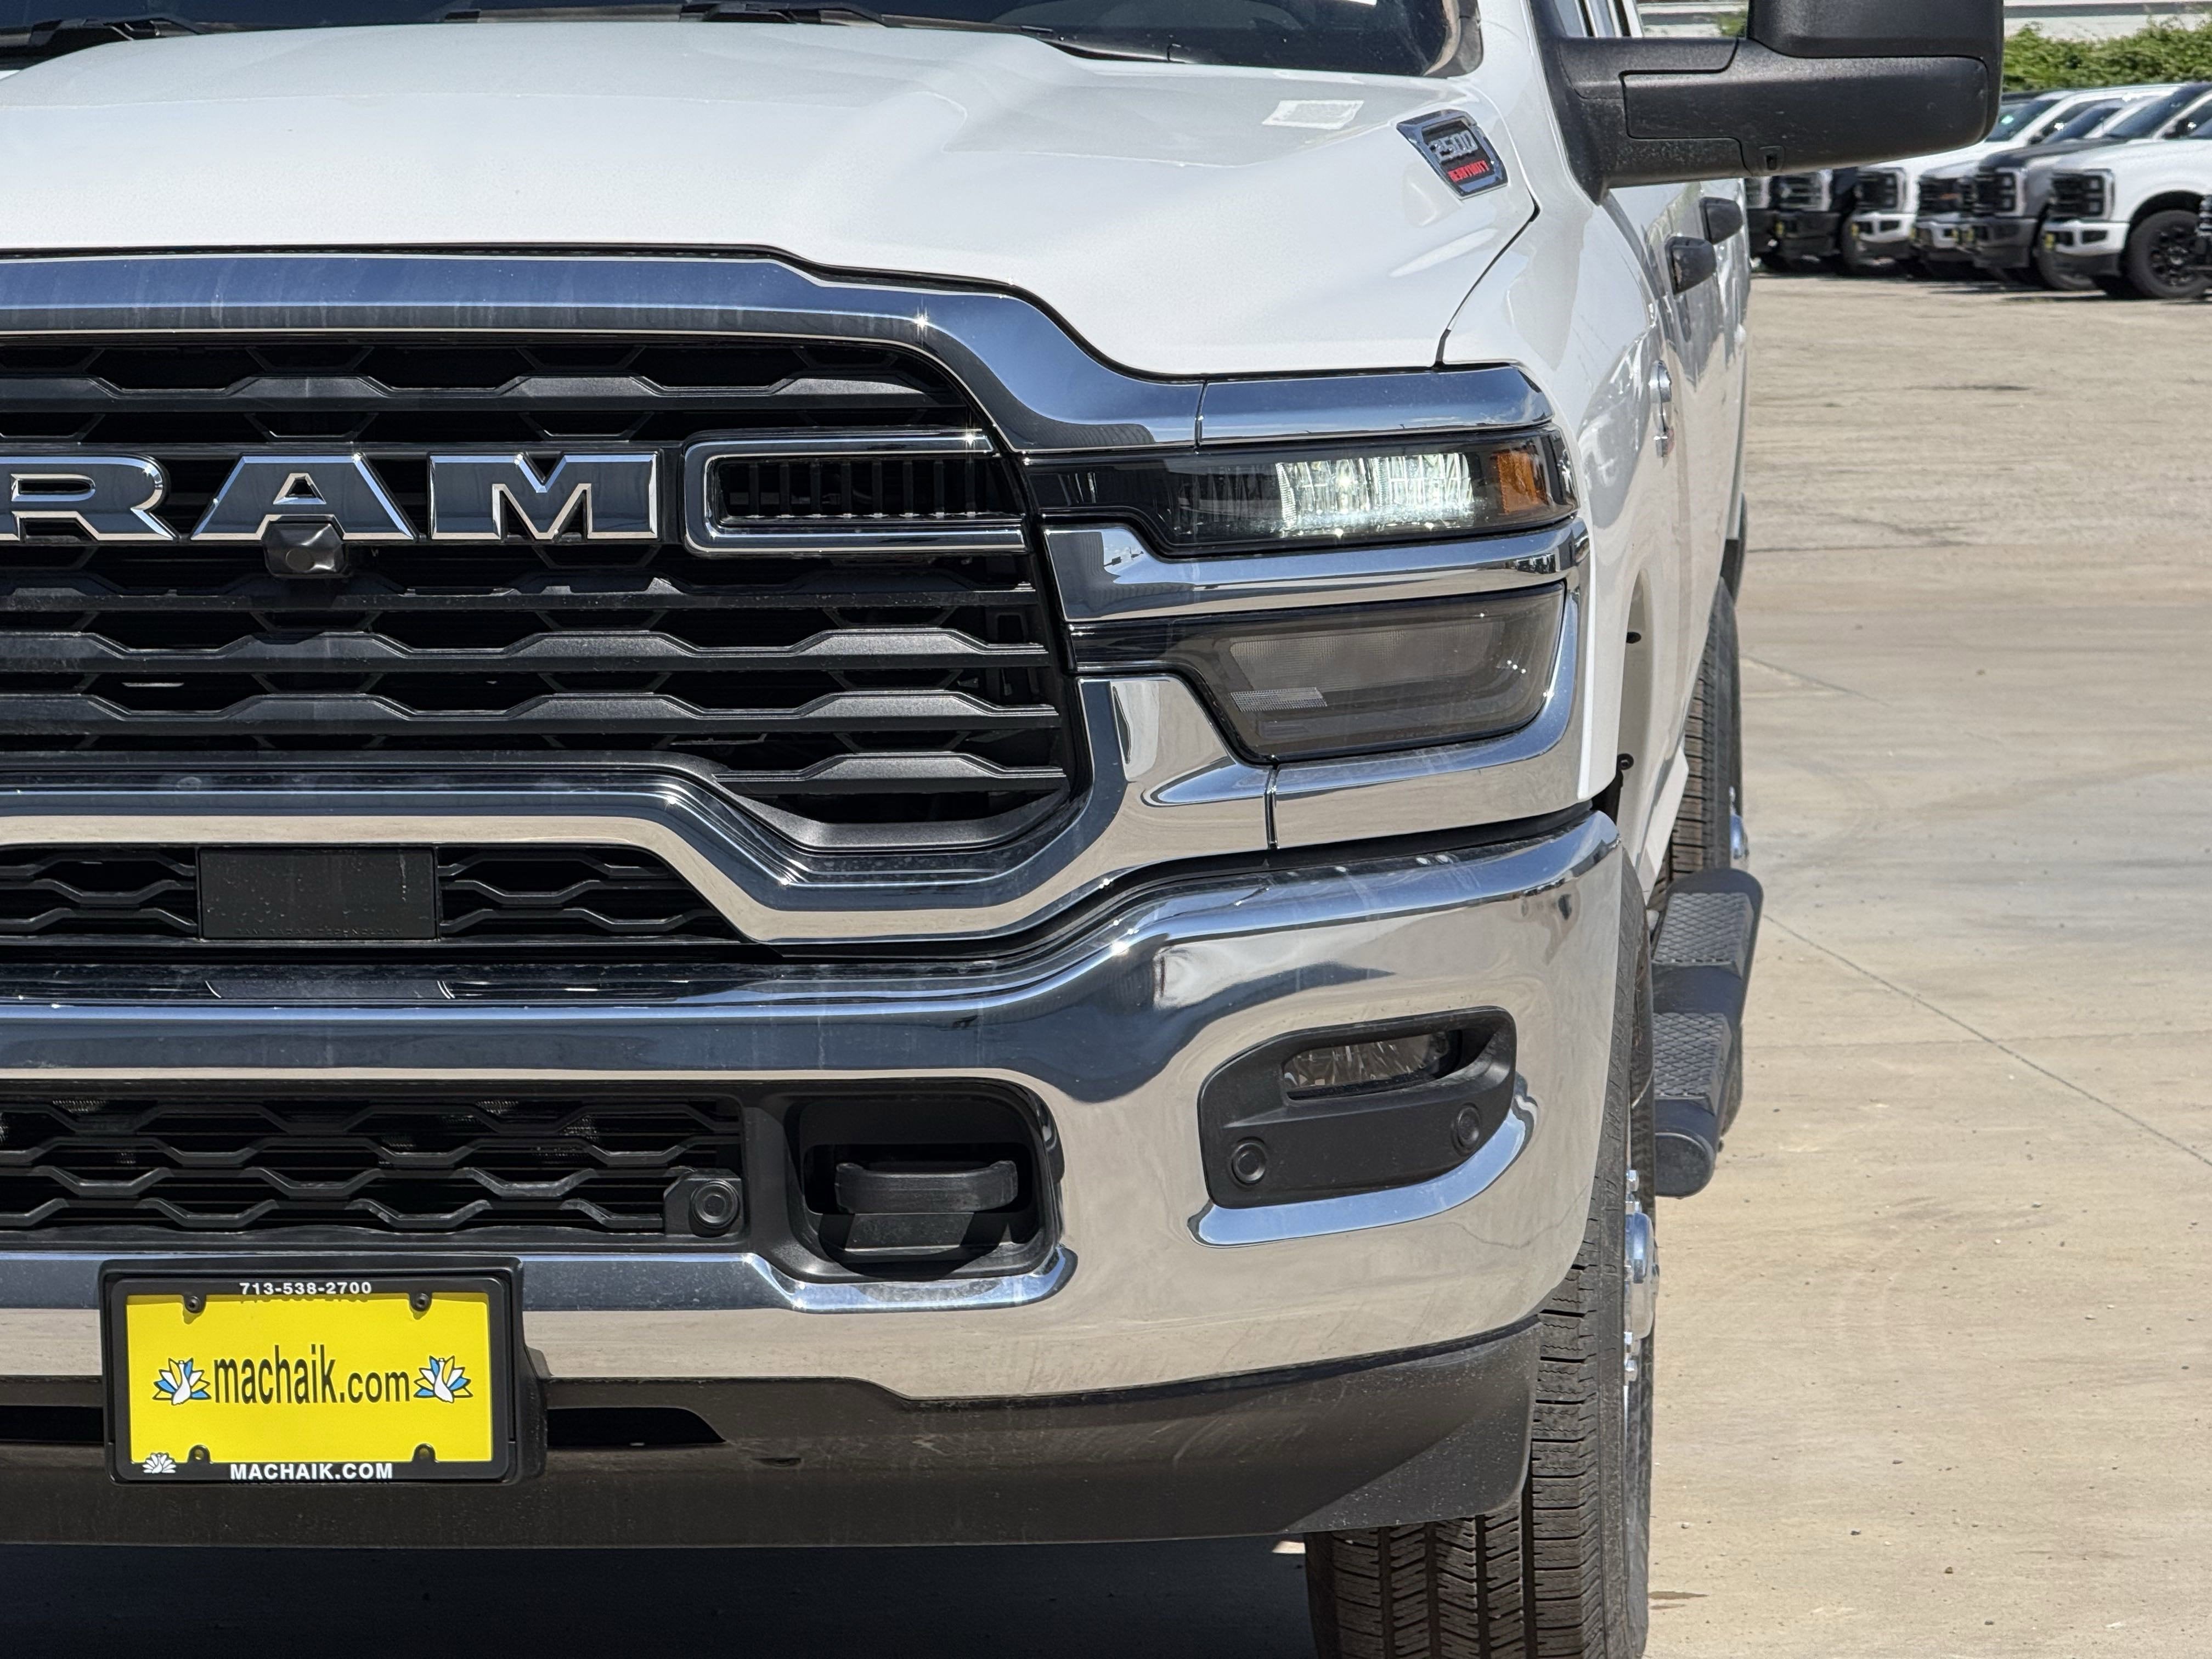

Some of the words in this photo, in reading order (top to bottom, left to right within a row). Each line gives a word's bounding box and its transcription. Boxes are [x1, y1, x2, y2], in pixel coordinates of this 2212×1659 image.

[0, 453, 660, 543] RAM
[239, 1282, 372, 1295] 713-538-2700
[213, 1344, 411, 1404] machaik.com
[230, 1463, 393, 1480] MACHAIK.COM
